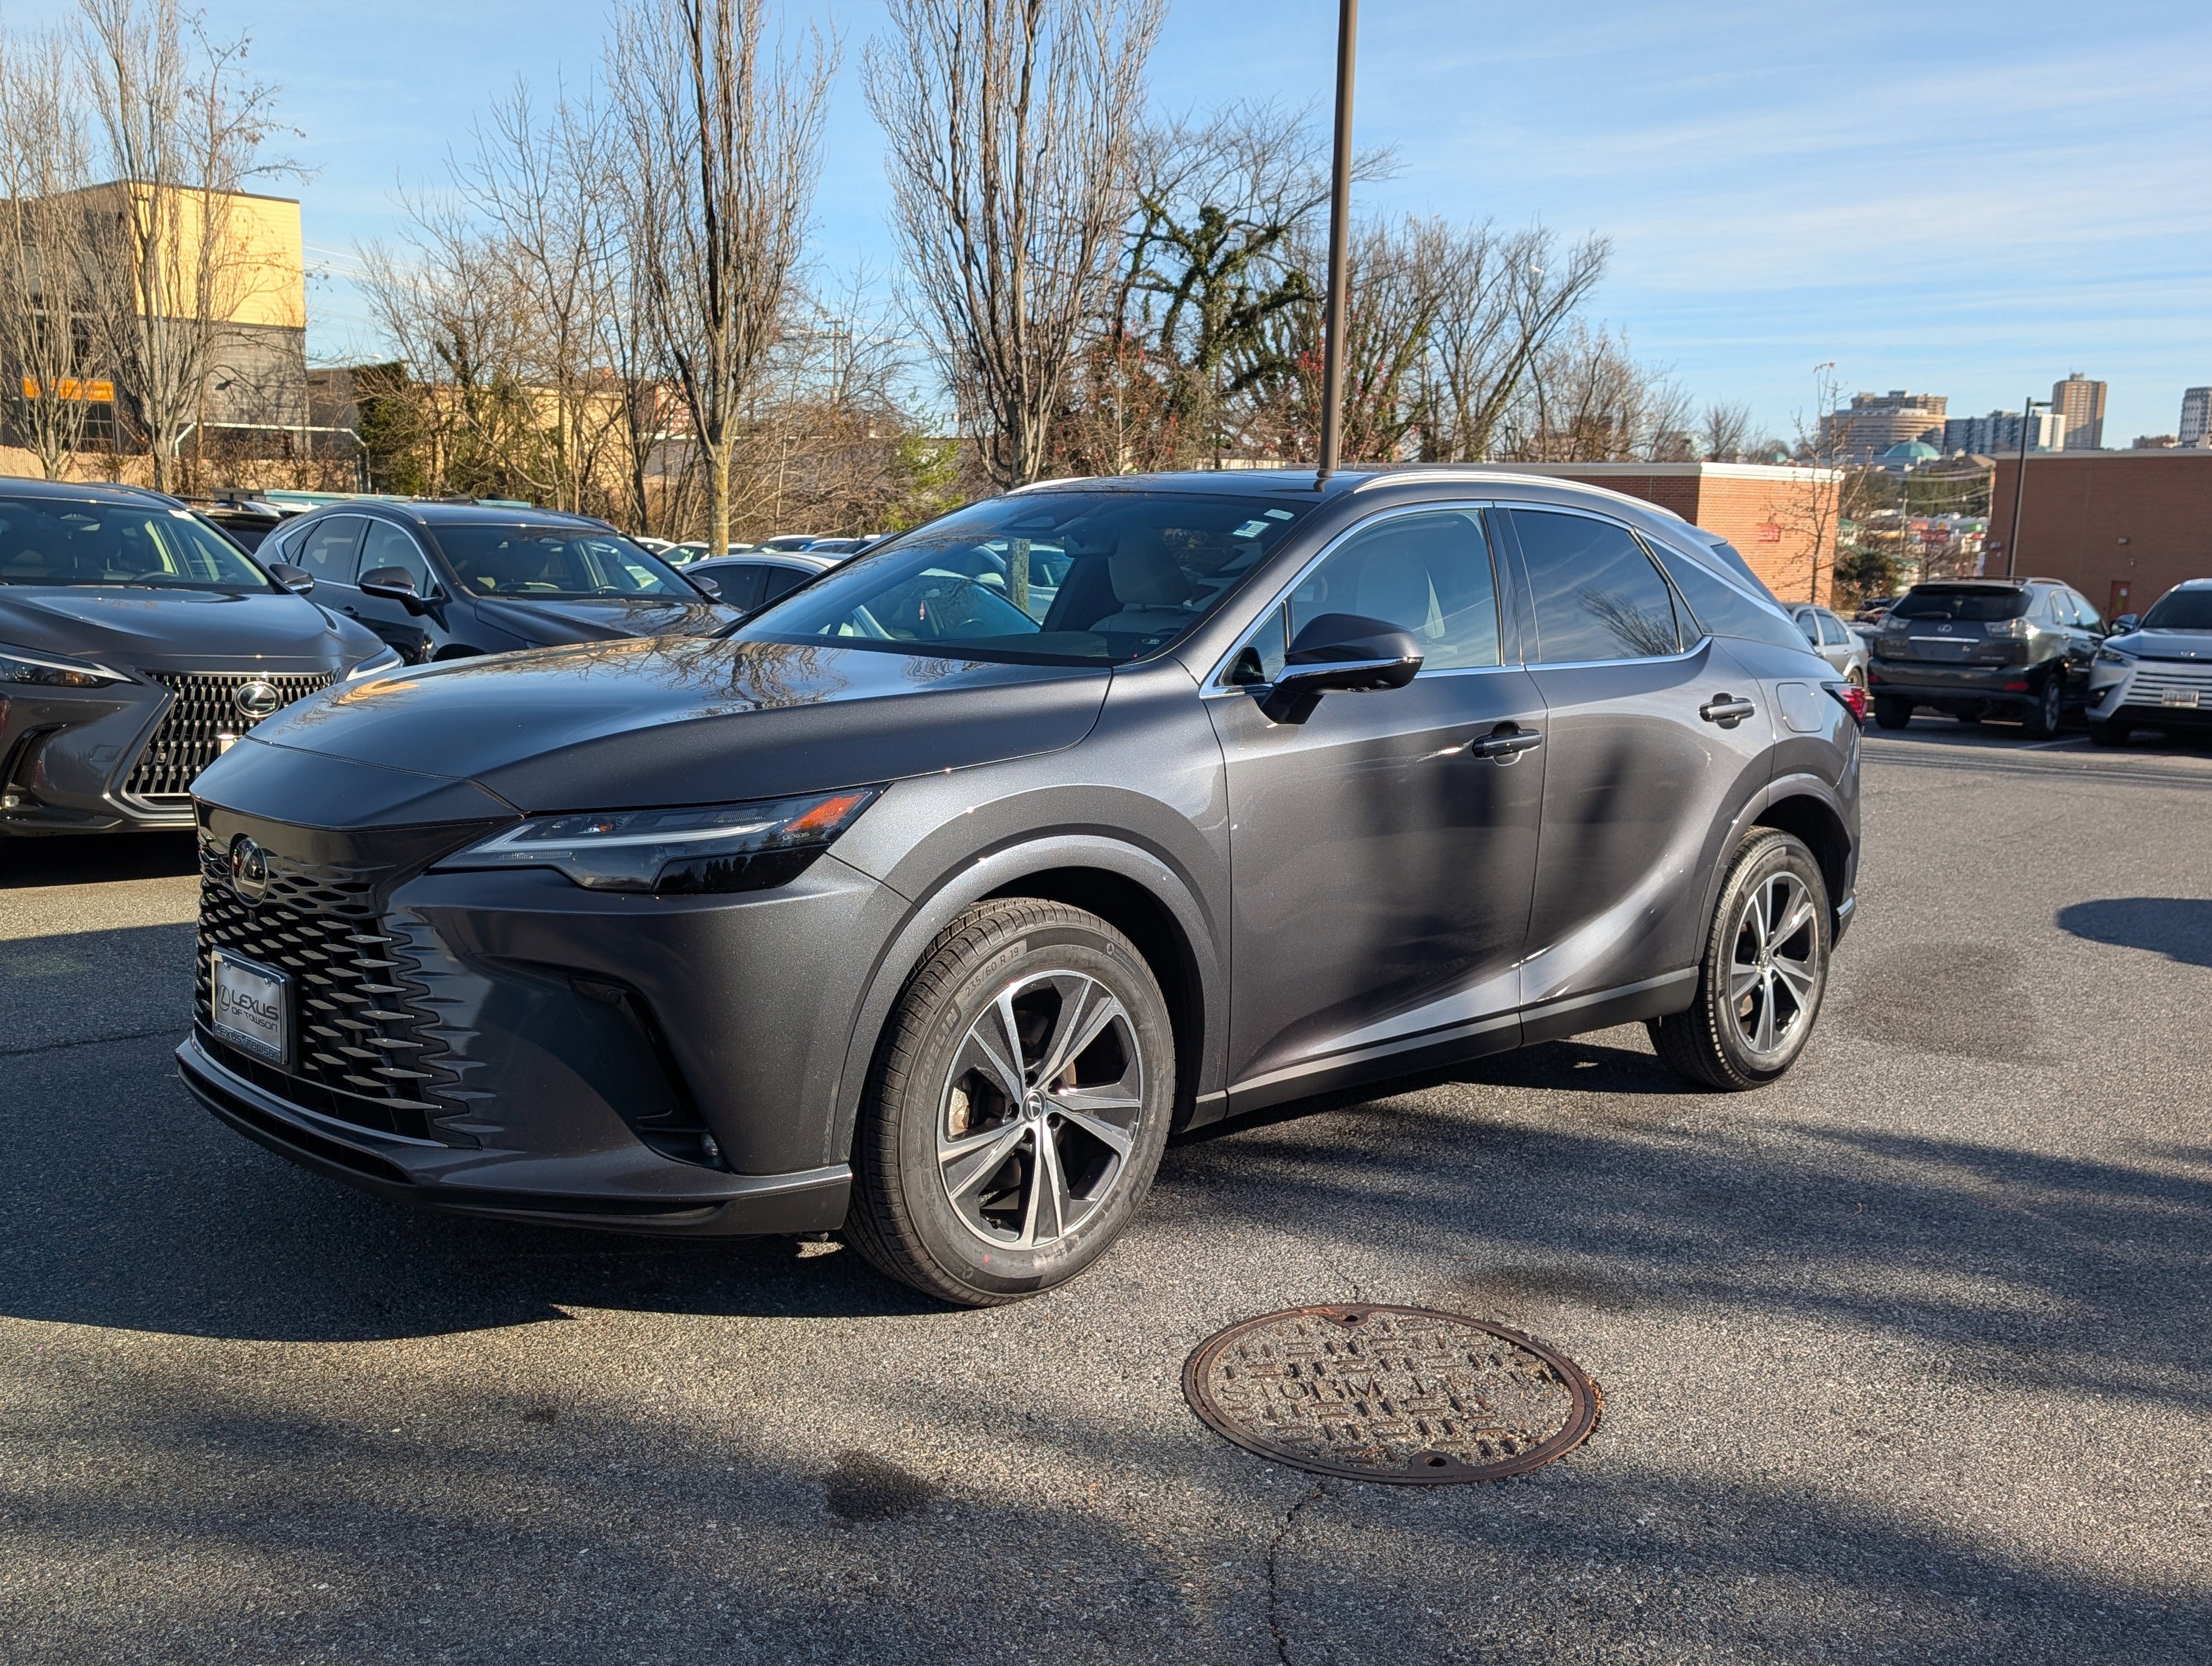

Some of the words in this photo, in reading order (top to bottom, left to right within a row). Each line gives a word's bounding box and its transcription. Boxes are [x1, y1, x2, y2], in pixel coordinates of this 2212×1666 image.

[782, 832, 809, 840] LEXUS
[965, 961, 997, 998] 235/60
[1000, 954, 1006, 965] R
[1009, 946, 1019, 959] 19
[232, 989, 279, 1021] LEXUS
[232, 1006, 243, 1016] OF
[243, 1011, 278, 1033] TOWSON
[215, 1024, 242, 1045] LEXUS
[913, 1002, 959, 1117] MICHELIN
